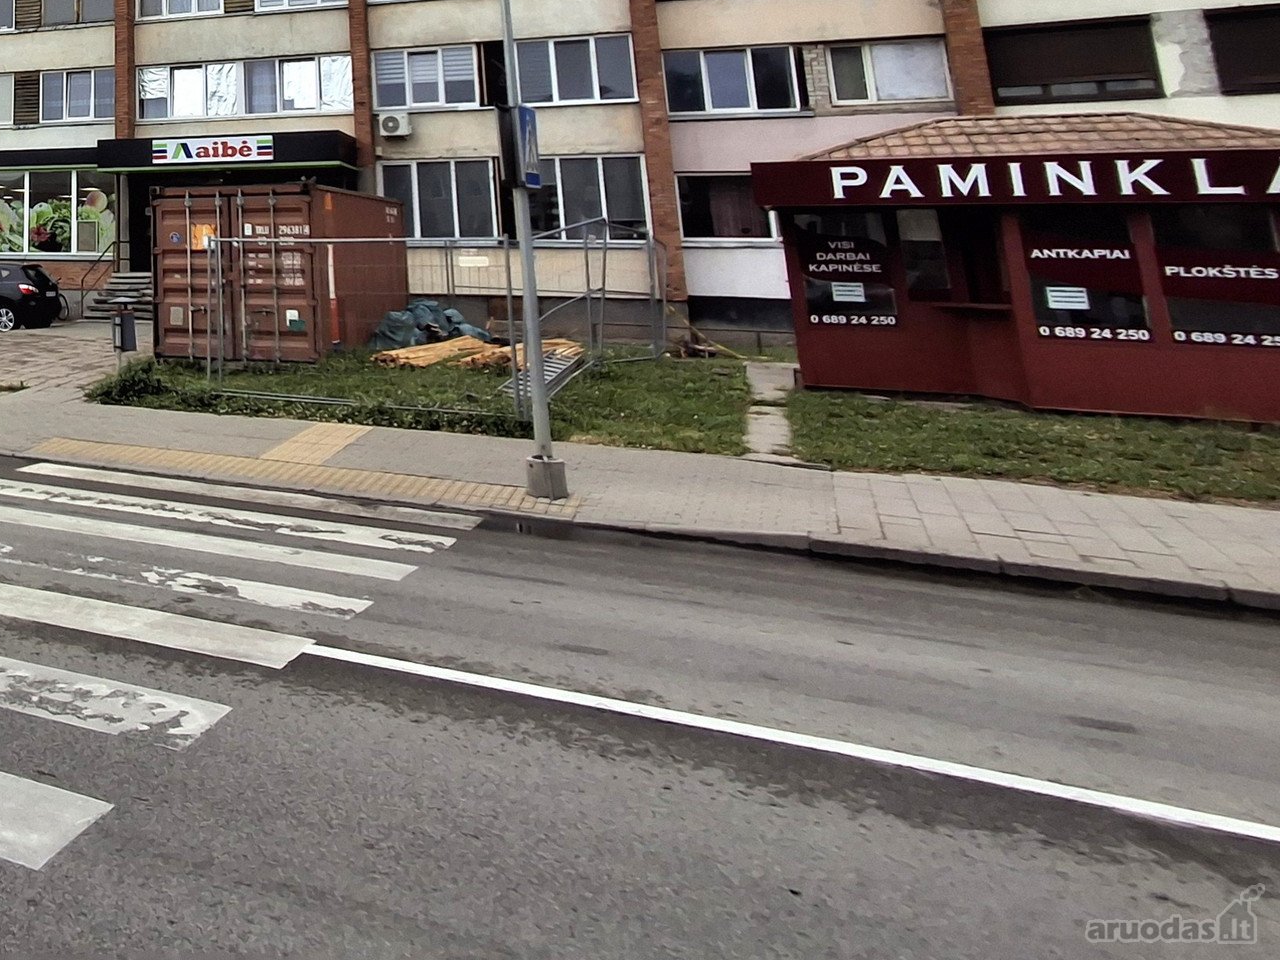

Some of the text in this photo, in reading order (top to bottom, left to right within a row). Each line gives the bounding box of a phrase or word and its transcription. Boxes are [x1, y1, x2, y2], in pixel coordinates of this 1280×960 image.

[828, 241, 855, 249] VISI
[816, 252, 871, 261] DARBAI
[1030, 249, 1131, 259] ANTKAPIAI
[808, 262, 882, 273] KAPINĖSE
[1164, 264, 1280, 279] PLOKŠTĖS
[810, 314, 896, 325] 0 689 24 250
[1039, 326, 1150, 341] 0 689 24 250
[1173, 330, 1187, 341] 0
[1190, 331, 1227, 344] 689
[1230, 333, 1257, 345] 24
